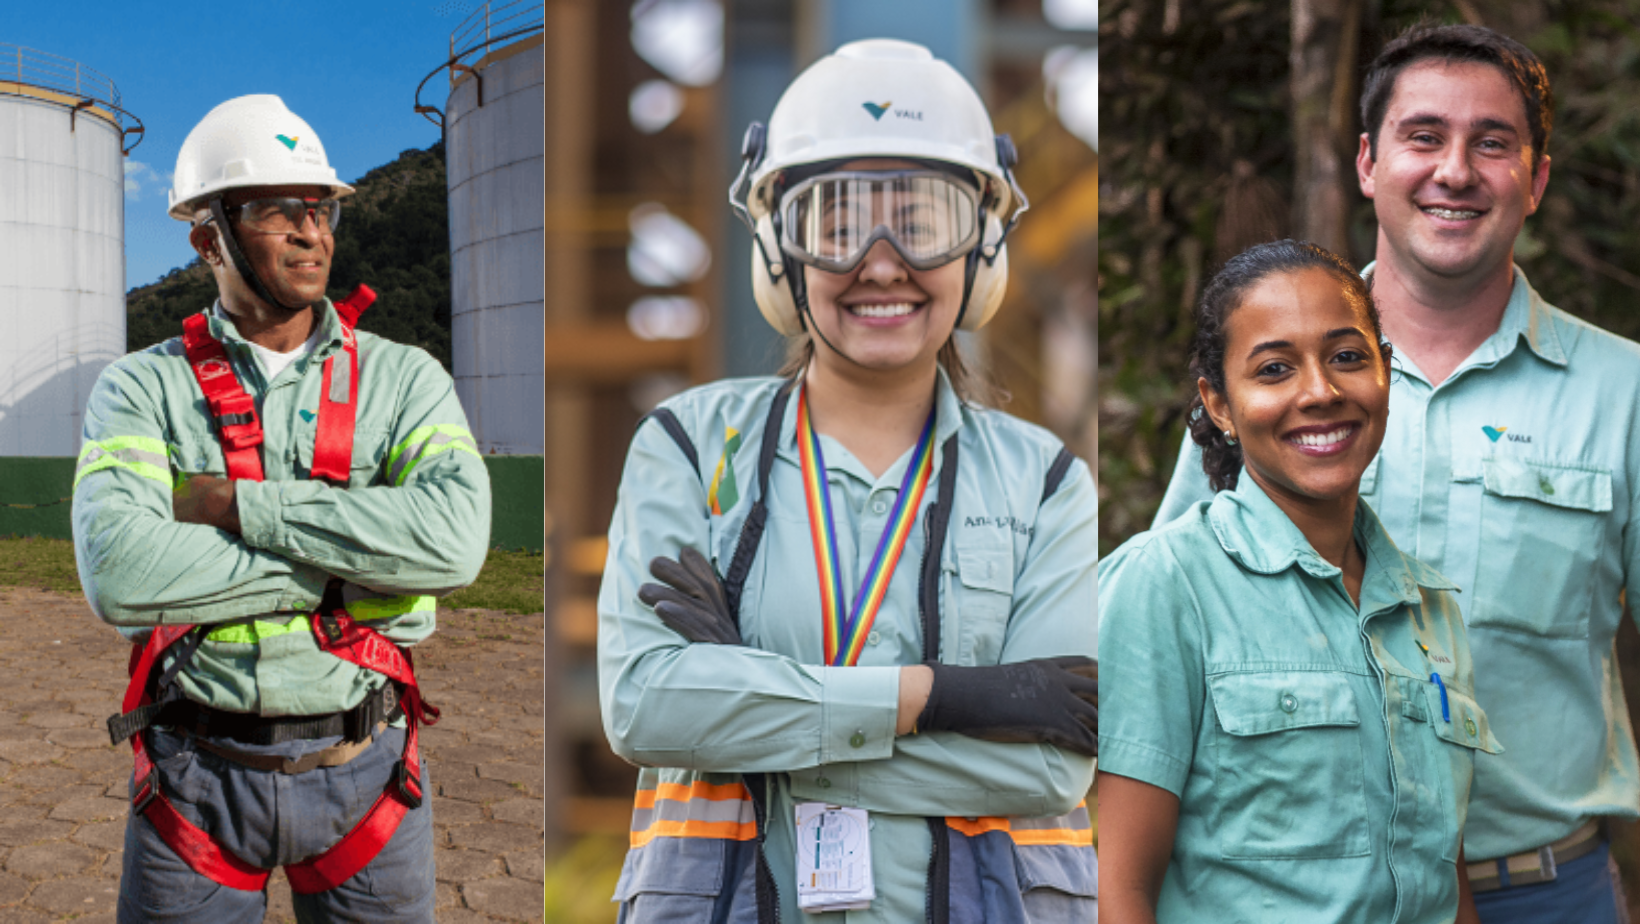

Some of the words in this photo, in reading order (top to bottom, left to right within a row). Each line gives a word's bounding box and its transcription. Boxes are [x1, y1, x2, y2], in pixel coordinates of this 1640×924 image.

[894, 109, 923, 121] VALE
[301, 144, 320, 155] VAL
[1507, 433, 1532, 444] VALE
